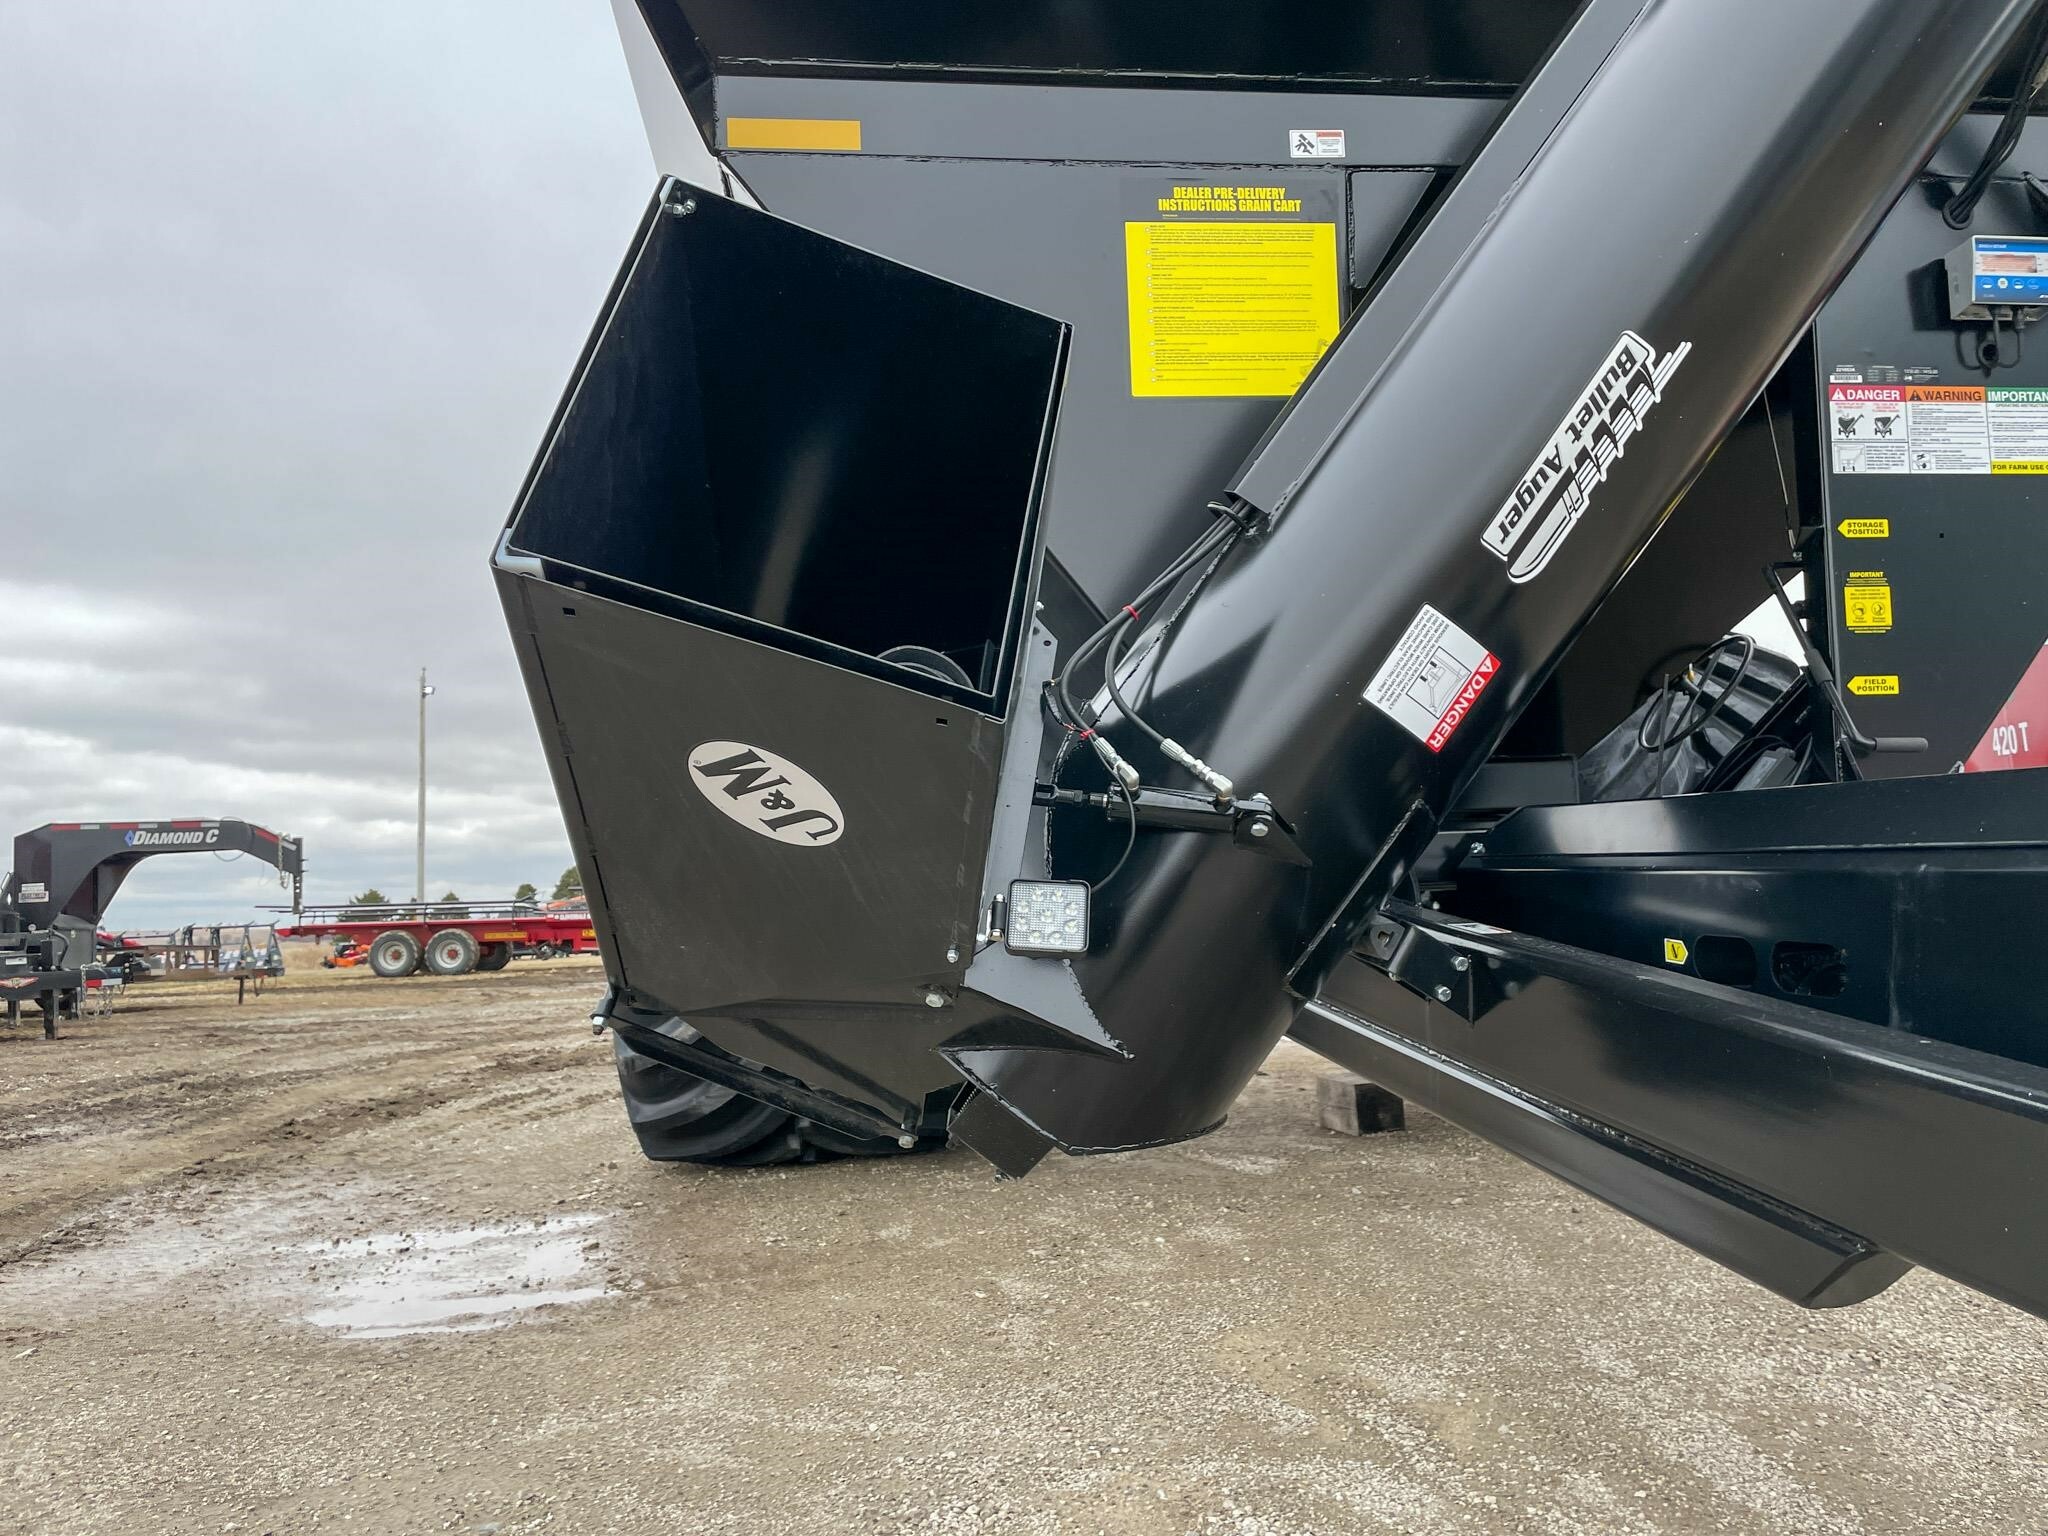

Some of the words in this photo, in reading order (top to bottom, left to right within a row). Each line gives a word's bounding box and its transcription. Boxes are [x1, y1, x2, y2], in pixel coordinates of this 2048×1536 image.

[1173, 187, 1212, 199] DEALER
[1213, 187, 1286, 200] PRE-DELIVERY
[1158, 199, 1237, 211] INSTRUCTIONS
[1238, 200, 1272, 212] GRAIN
[1273, 200, 1302, 212] CART
[1565, 345, 1637, 444] Bullet
[1847, 389, 1901, 401] DANGER
[1923, 390, 1982, 401] WARNING
[1498, 443, 1567, 544] Auger
[1422, 608, 1429, 616] TO
[1433, 619, 1445, 633] FROM
[1418, 632, 1435, 655] CONTACT
[1395, 665, 1412, 688] ELECTRIC
[1856, 684, 1895, 692] POSITION
[1427, 673, 1486, 749] DANGER
[1992, 725, 2017, 756] 420
[2018, 722, 2028, 752] T
[693, 748, 838, 841] J&M
[132, 830, 204, 846] DIAMOND
[205, 828, 219, 844] C
